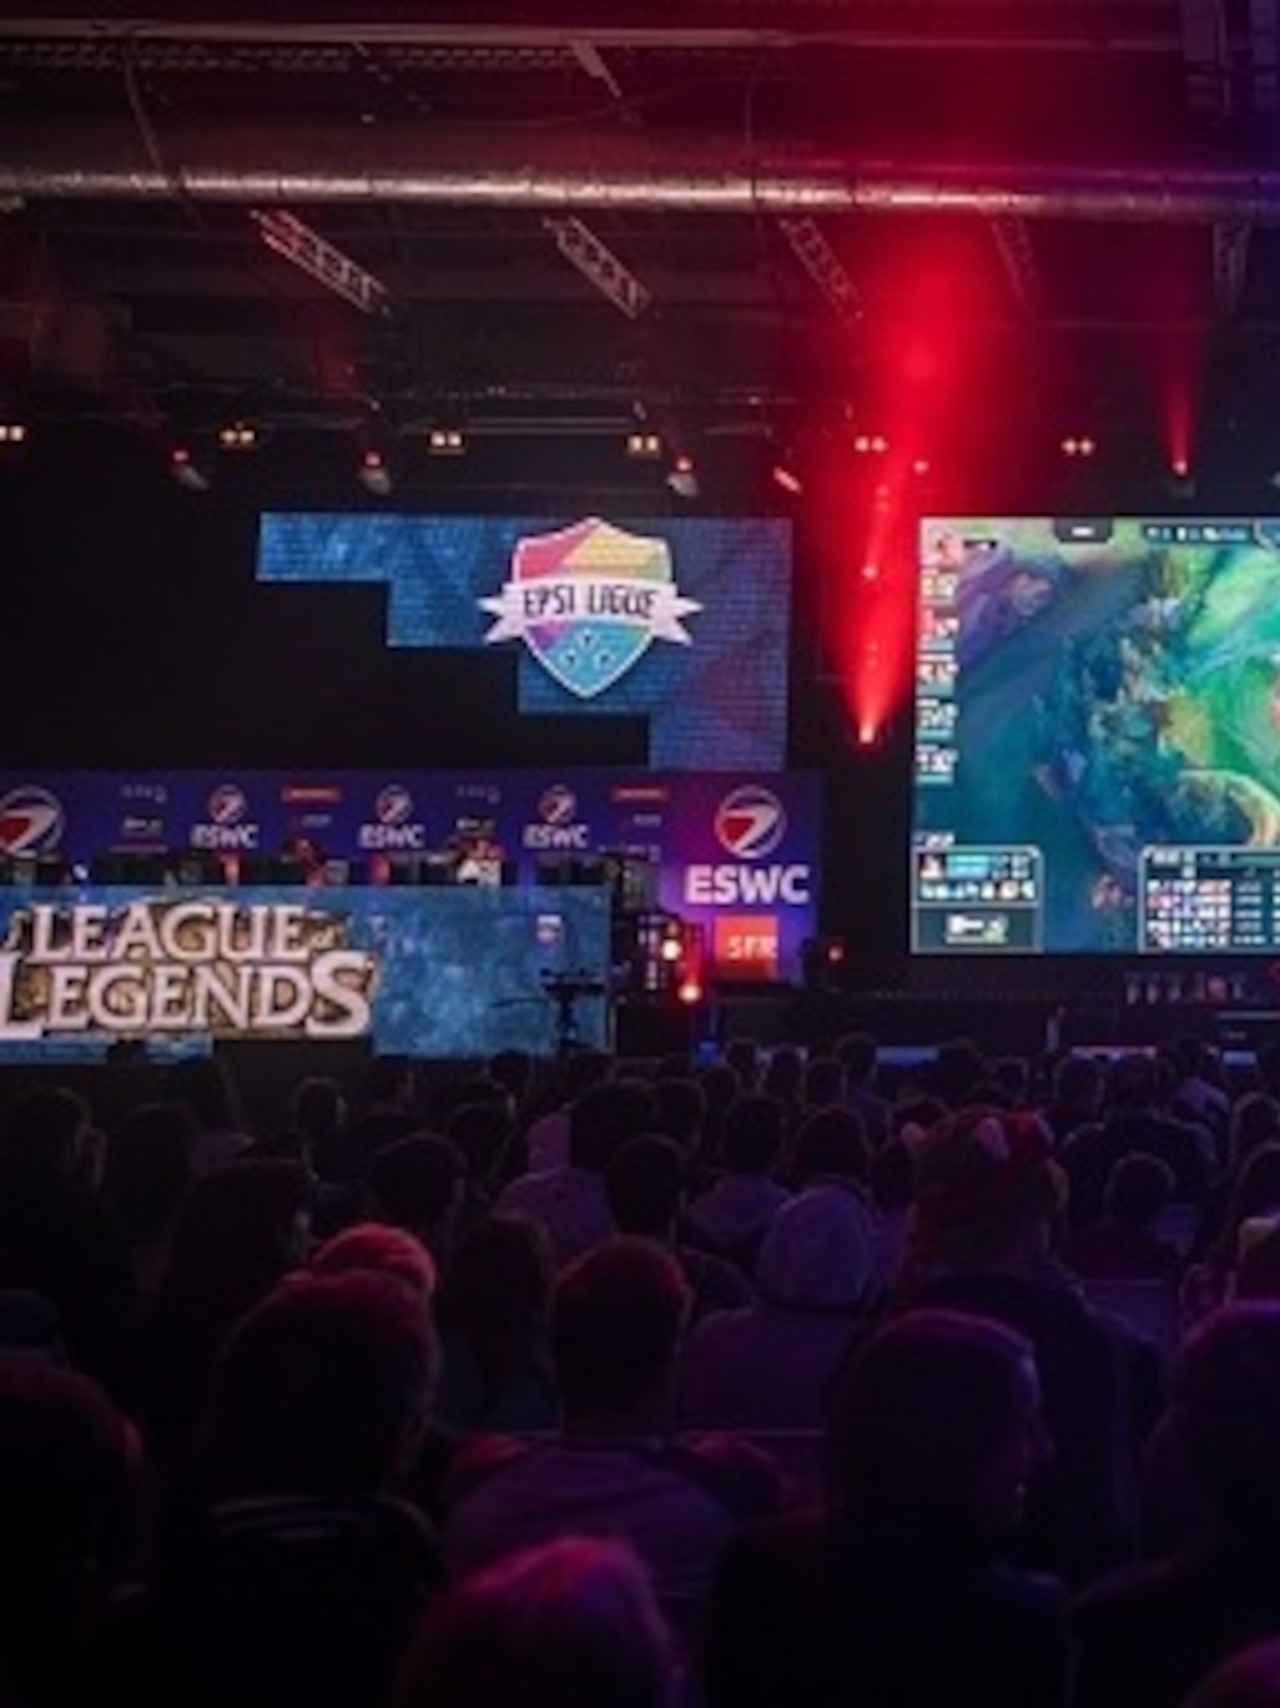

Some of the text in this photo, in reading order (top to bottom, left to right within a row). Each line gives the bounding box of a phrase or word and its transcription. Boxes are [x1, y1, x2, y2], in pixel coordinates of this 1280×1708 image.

[523, 584, 659, 617] EPSI LIGUE
[190, 823, 259, 849] ESWC
[360, 823, 425, 849] ESWC
[522, 823, 589, 849] ESWC
[684, 864, 810, 904] ESWC
[27, 903, 310, 960] LEAGUE
[728, 935, 778, 960] SFR
